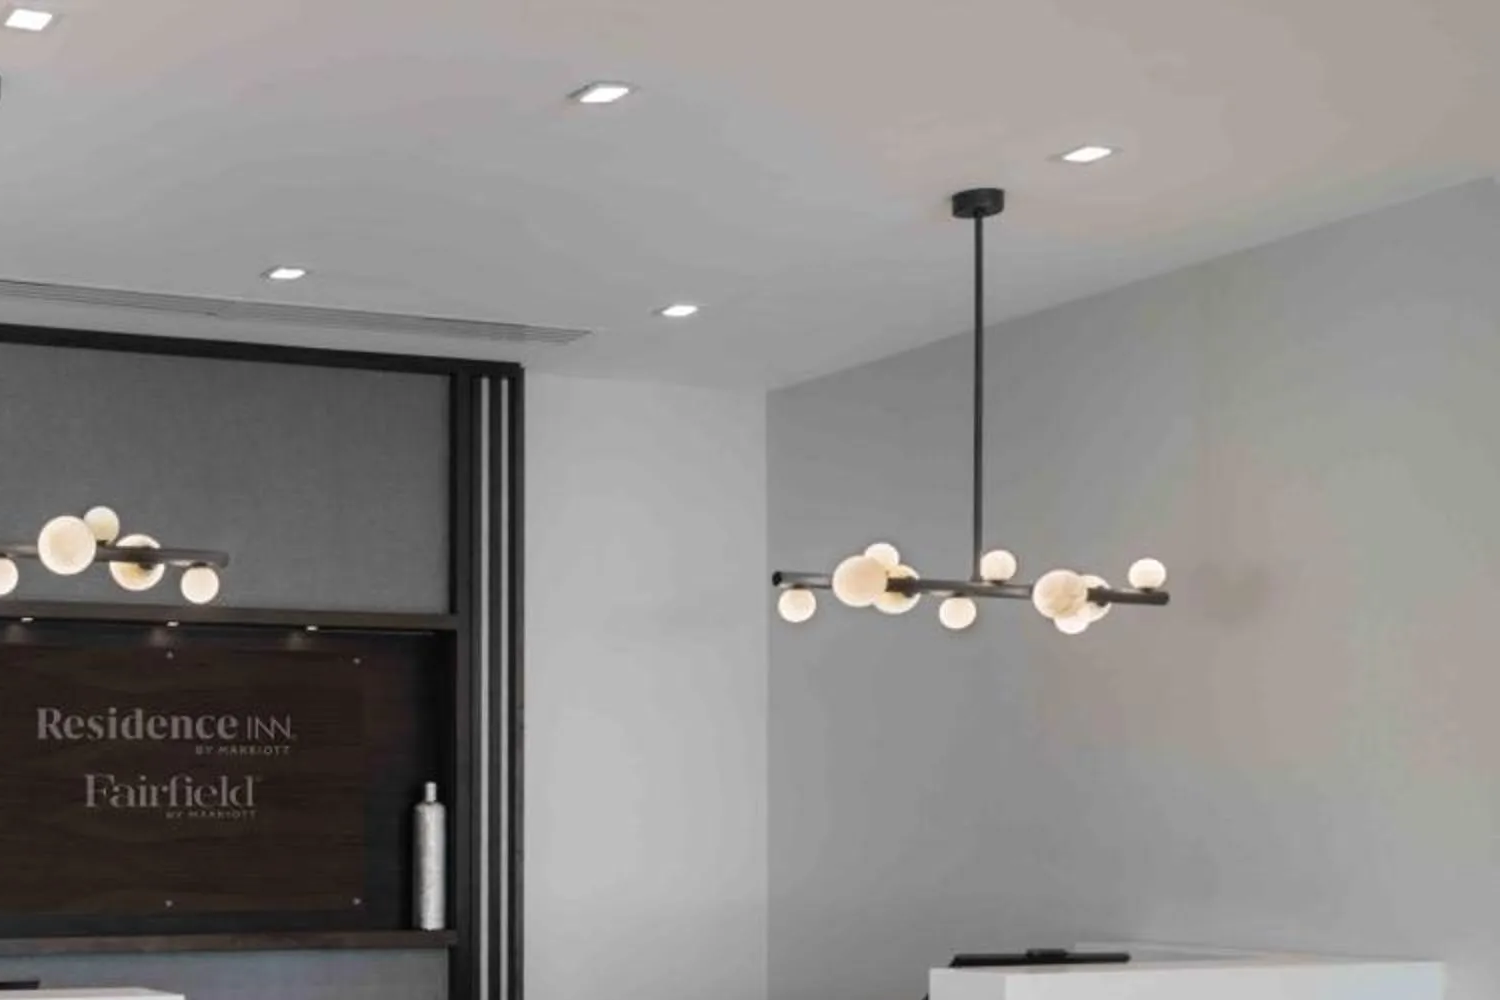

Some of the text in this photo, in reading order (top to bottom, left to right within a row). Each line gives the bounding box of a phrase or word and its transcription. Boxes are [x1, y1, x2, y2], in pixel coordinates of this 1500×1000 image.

[36, 706, 292, 740] Residence INN
[195, 745, 291, 756] BY MARRIOTT
[84, 773, 255, 808] Fairfield
